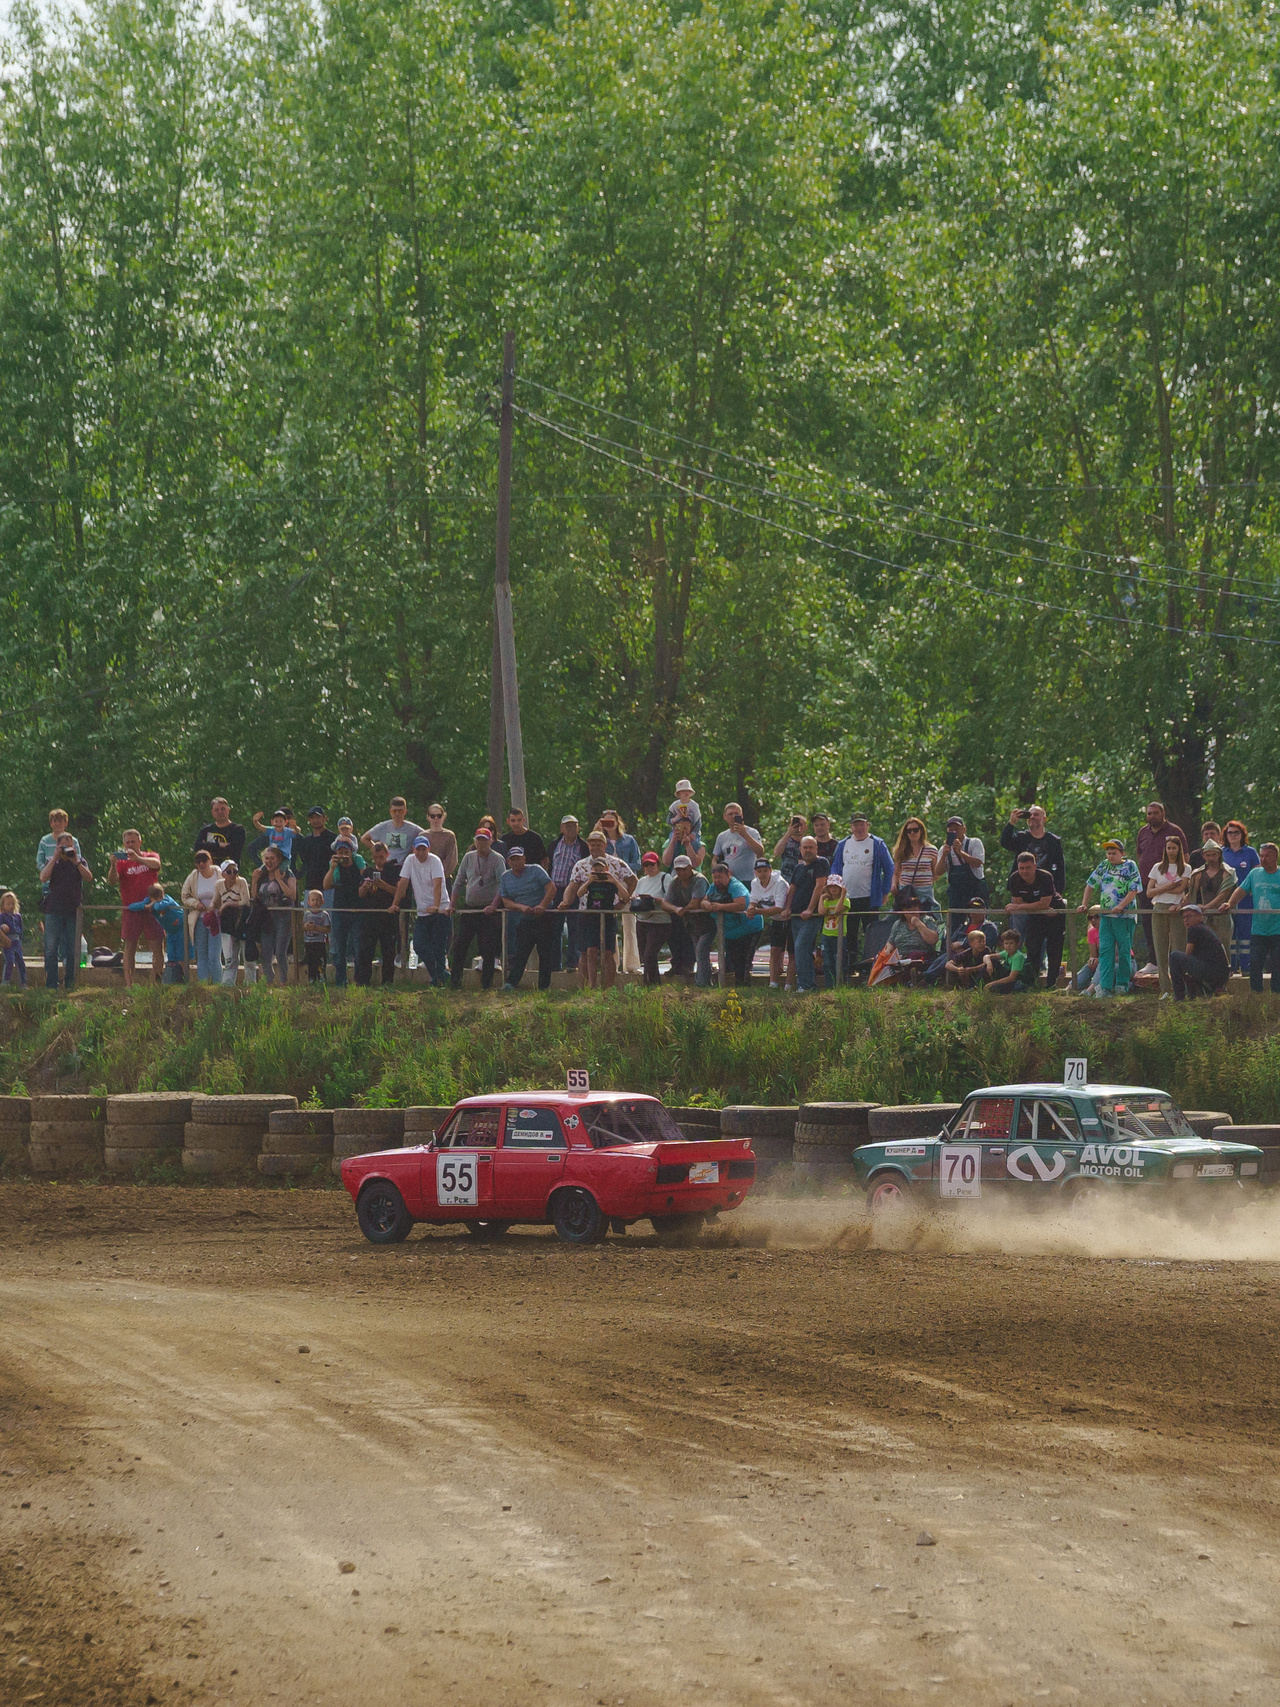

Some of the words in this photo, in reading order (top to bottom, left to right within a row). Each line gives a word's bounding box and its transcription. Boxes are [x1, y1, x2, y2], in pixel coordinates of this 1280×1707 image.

[568, 1070, 587, 1087] 55
[1068, 1062, 1083, 1080] 70
[1079, 1144, 1145, 1166] AVOL
[442, 1163, 473, 1192] 55
[945, 1154, 976, 1184] 70
[1080, 1164, 1121, 1176] MOTOR
[1124, 1167, 1144, 1178] OIL
[454, 1196, 469, 1204] Реж
